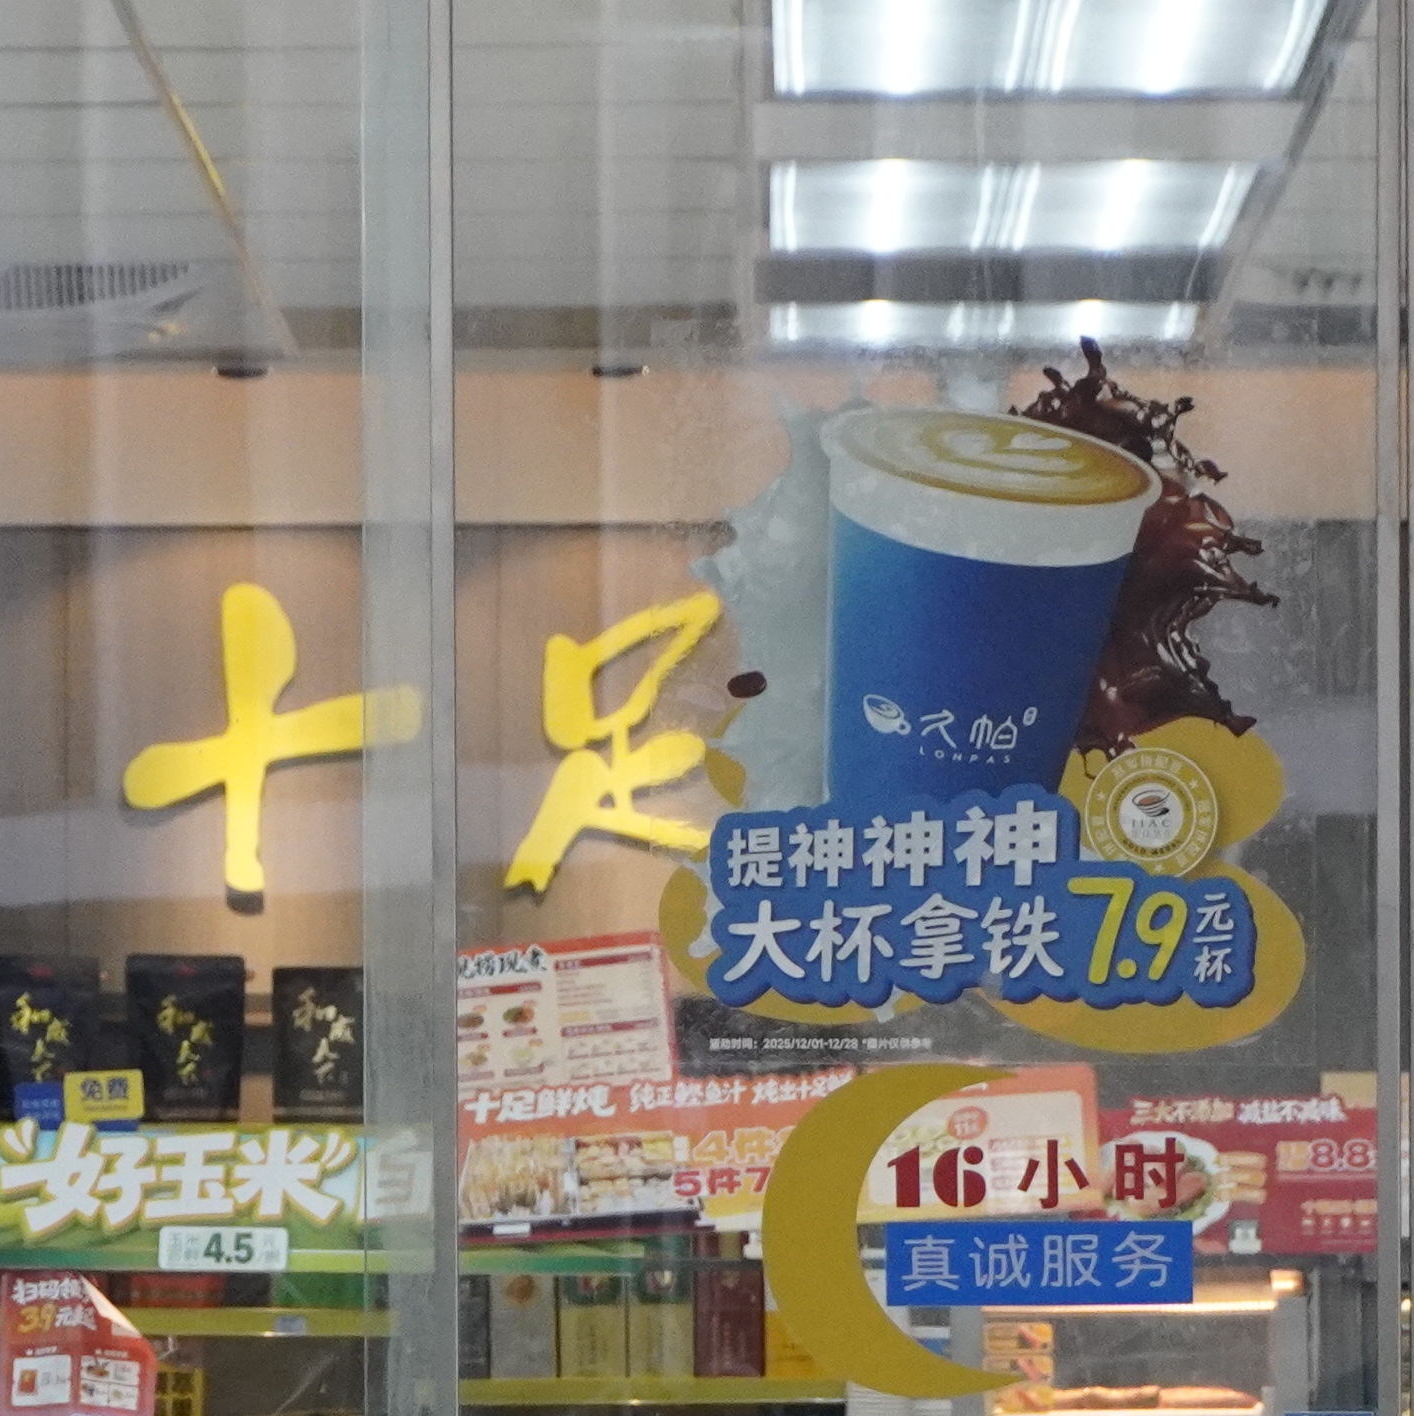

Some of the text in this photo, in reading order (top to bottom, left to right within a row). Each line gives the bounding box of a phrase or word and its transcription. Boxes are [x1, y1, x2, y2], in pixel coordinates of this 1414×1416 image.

[123, 582, 722, 892] 十足
[728, 801, 1058, 888] 提神神神
[723, 893, 1065, 982] 大杯拿铁
[1067, 877, 1187, 985] 7.9
[888, 1145, 986, 1207] 16
[203, 1233, 254, 1263] 4.5
[902, 1232, 1172, 1291] 真诚服务
